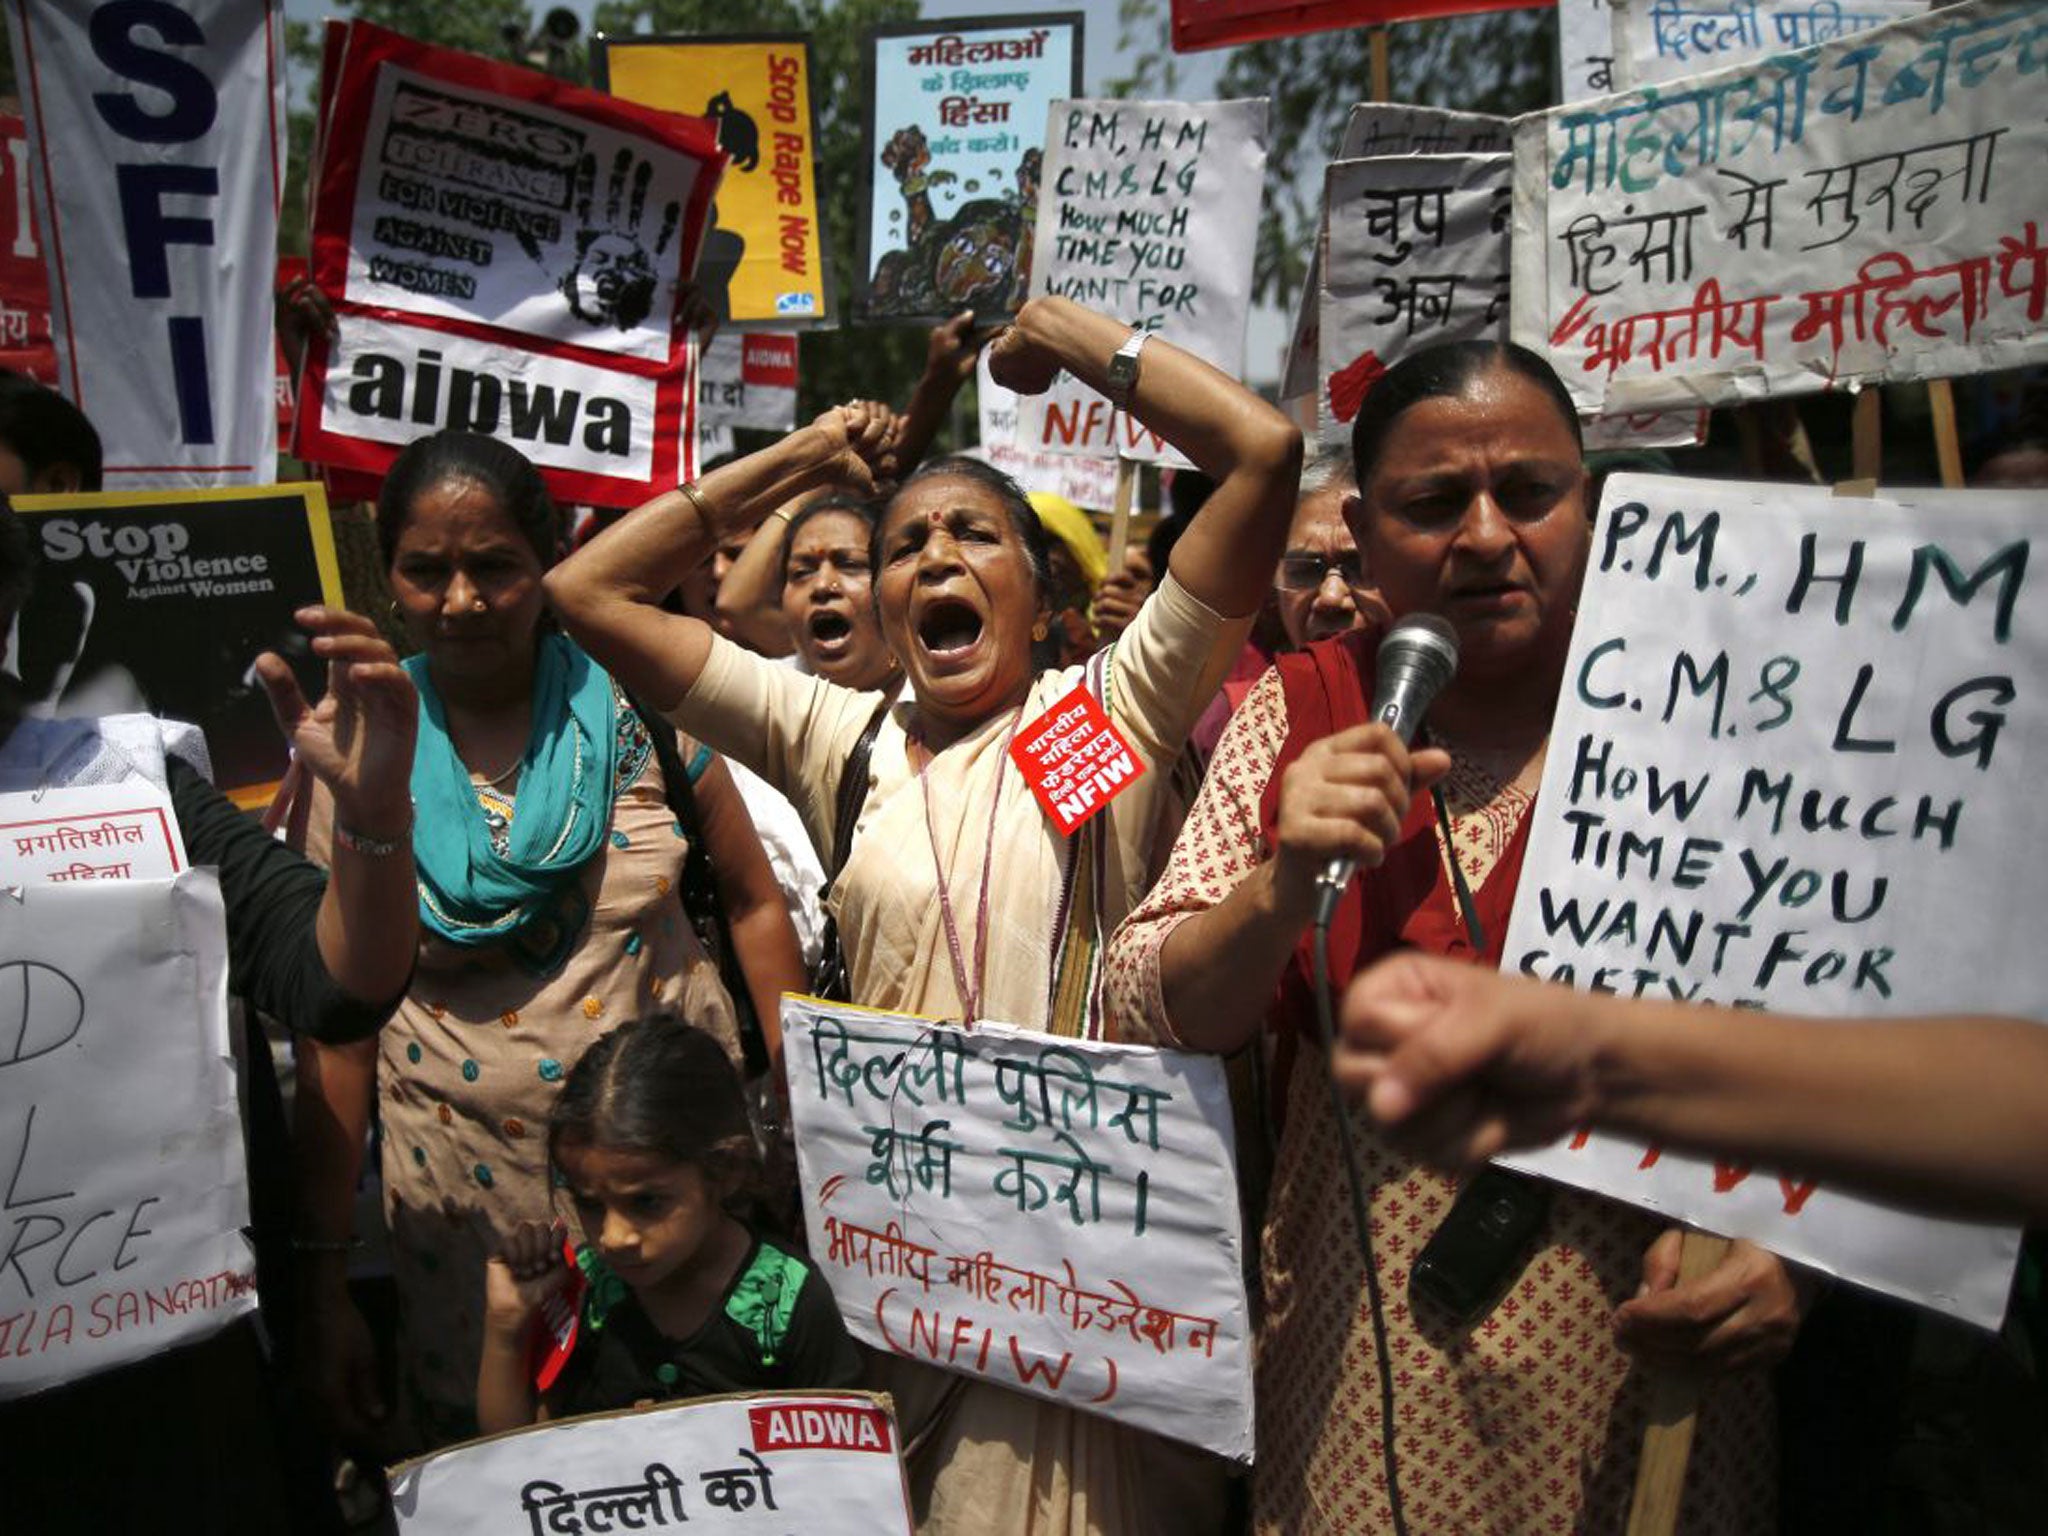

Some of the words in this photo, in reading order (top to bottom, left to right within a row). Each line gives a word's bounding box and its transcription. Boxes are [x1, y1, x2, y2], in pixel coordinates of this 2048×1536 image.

[907, 30, 1050, 65] महिलाओं
[767, 54, 798, 123] Stop
[921, 73, 943, 92] के
[939, 97, 1011, 127] हिंसा
[395, 92, 580, 167] ZERO
[387, 133, 568, 201] TOLERANCE
[770, 133, 803, 206] Rape
[90, 0, 219, 445] SFI
[376, 219, 491, 264] AGAINST
[382, 176, 434, 209] FOR
[440, 191, 560, 242] VIOLENCE
[1117, 207, 1188, 238] MUCH
[1363, 186, 1454, 266] चुप
[372, 258, 475, 298] WOMEN
[1056, 235, 1121, 266] TIME
[1129, 241, 1186, 278] YOU
[1557, 203, 1708, 297] हिंसा
[1046, 275, 1130, 306] WANT
[1138, 279, 1198, 317] FOR
[349, 350, 630, 456] aipwa
[41, 518, 190, 562] Stop
[115, 553, 269, 585] Violence
[126, 584, 187, 600] Against
[188, 577, 275, 598] Women
[1025, 703, 1088, 754] भारतीय
[1056, 751, 1134, 825] NFIW
[1736, 768, 1964, 852] MUCH
[14, 822, 144, 857] प्रगतिशील
[1564, 810, 1724, 890] TIME
[1737, 847, 1889, 925] YOU
[1539, 887, 1752, 976] WANT
[1754, 931, 1894, 999] FOR
[809, 1016, 979, 1107] दिल्ली
[994, 1045, 1173, 1151] पुलिस
[767, 1409, 883, 1449] AIDWA
[520, 1462, 689, 1536] दिल्ली
[700, 1448, 779, 1513] को
